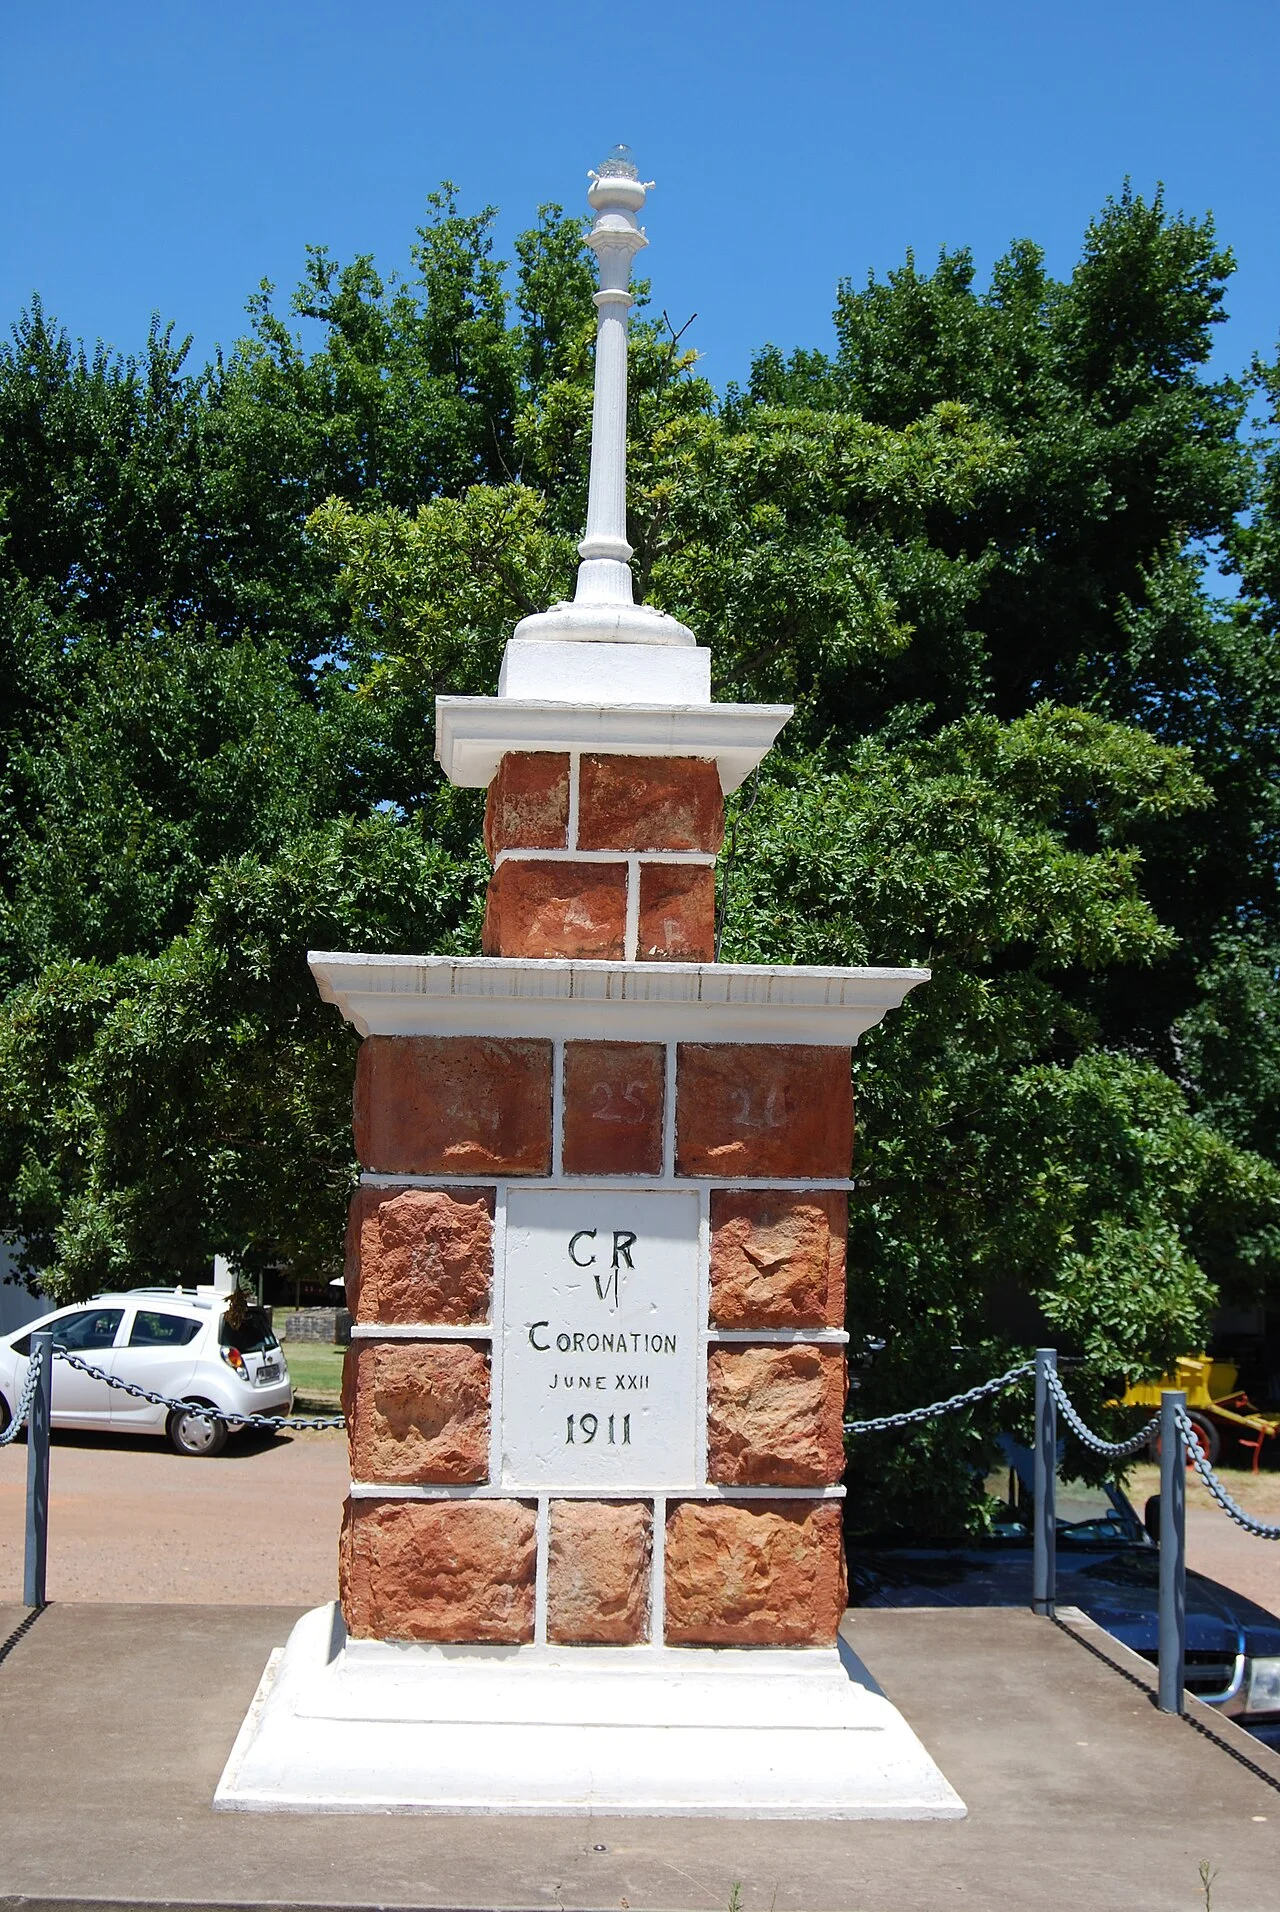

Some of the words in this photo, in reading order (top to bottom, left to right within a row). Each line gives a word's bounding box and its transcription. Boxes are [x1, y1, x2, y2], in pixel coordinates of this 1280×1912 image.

[592, 1081, 648, 1124] 25
[528, 1320, 677, 1353] CORONATION
[549, 1373, 607, 1390] JUNE
[615, 1374, 649, 1390] XXII
[565, 1412, 632, 1445] 1911
